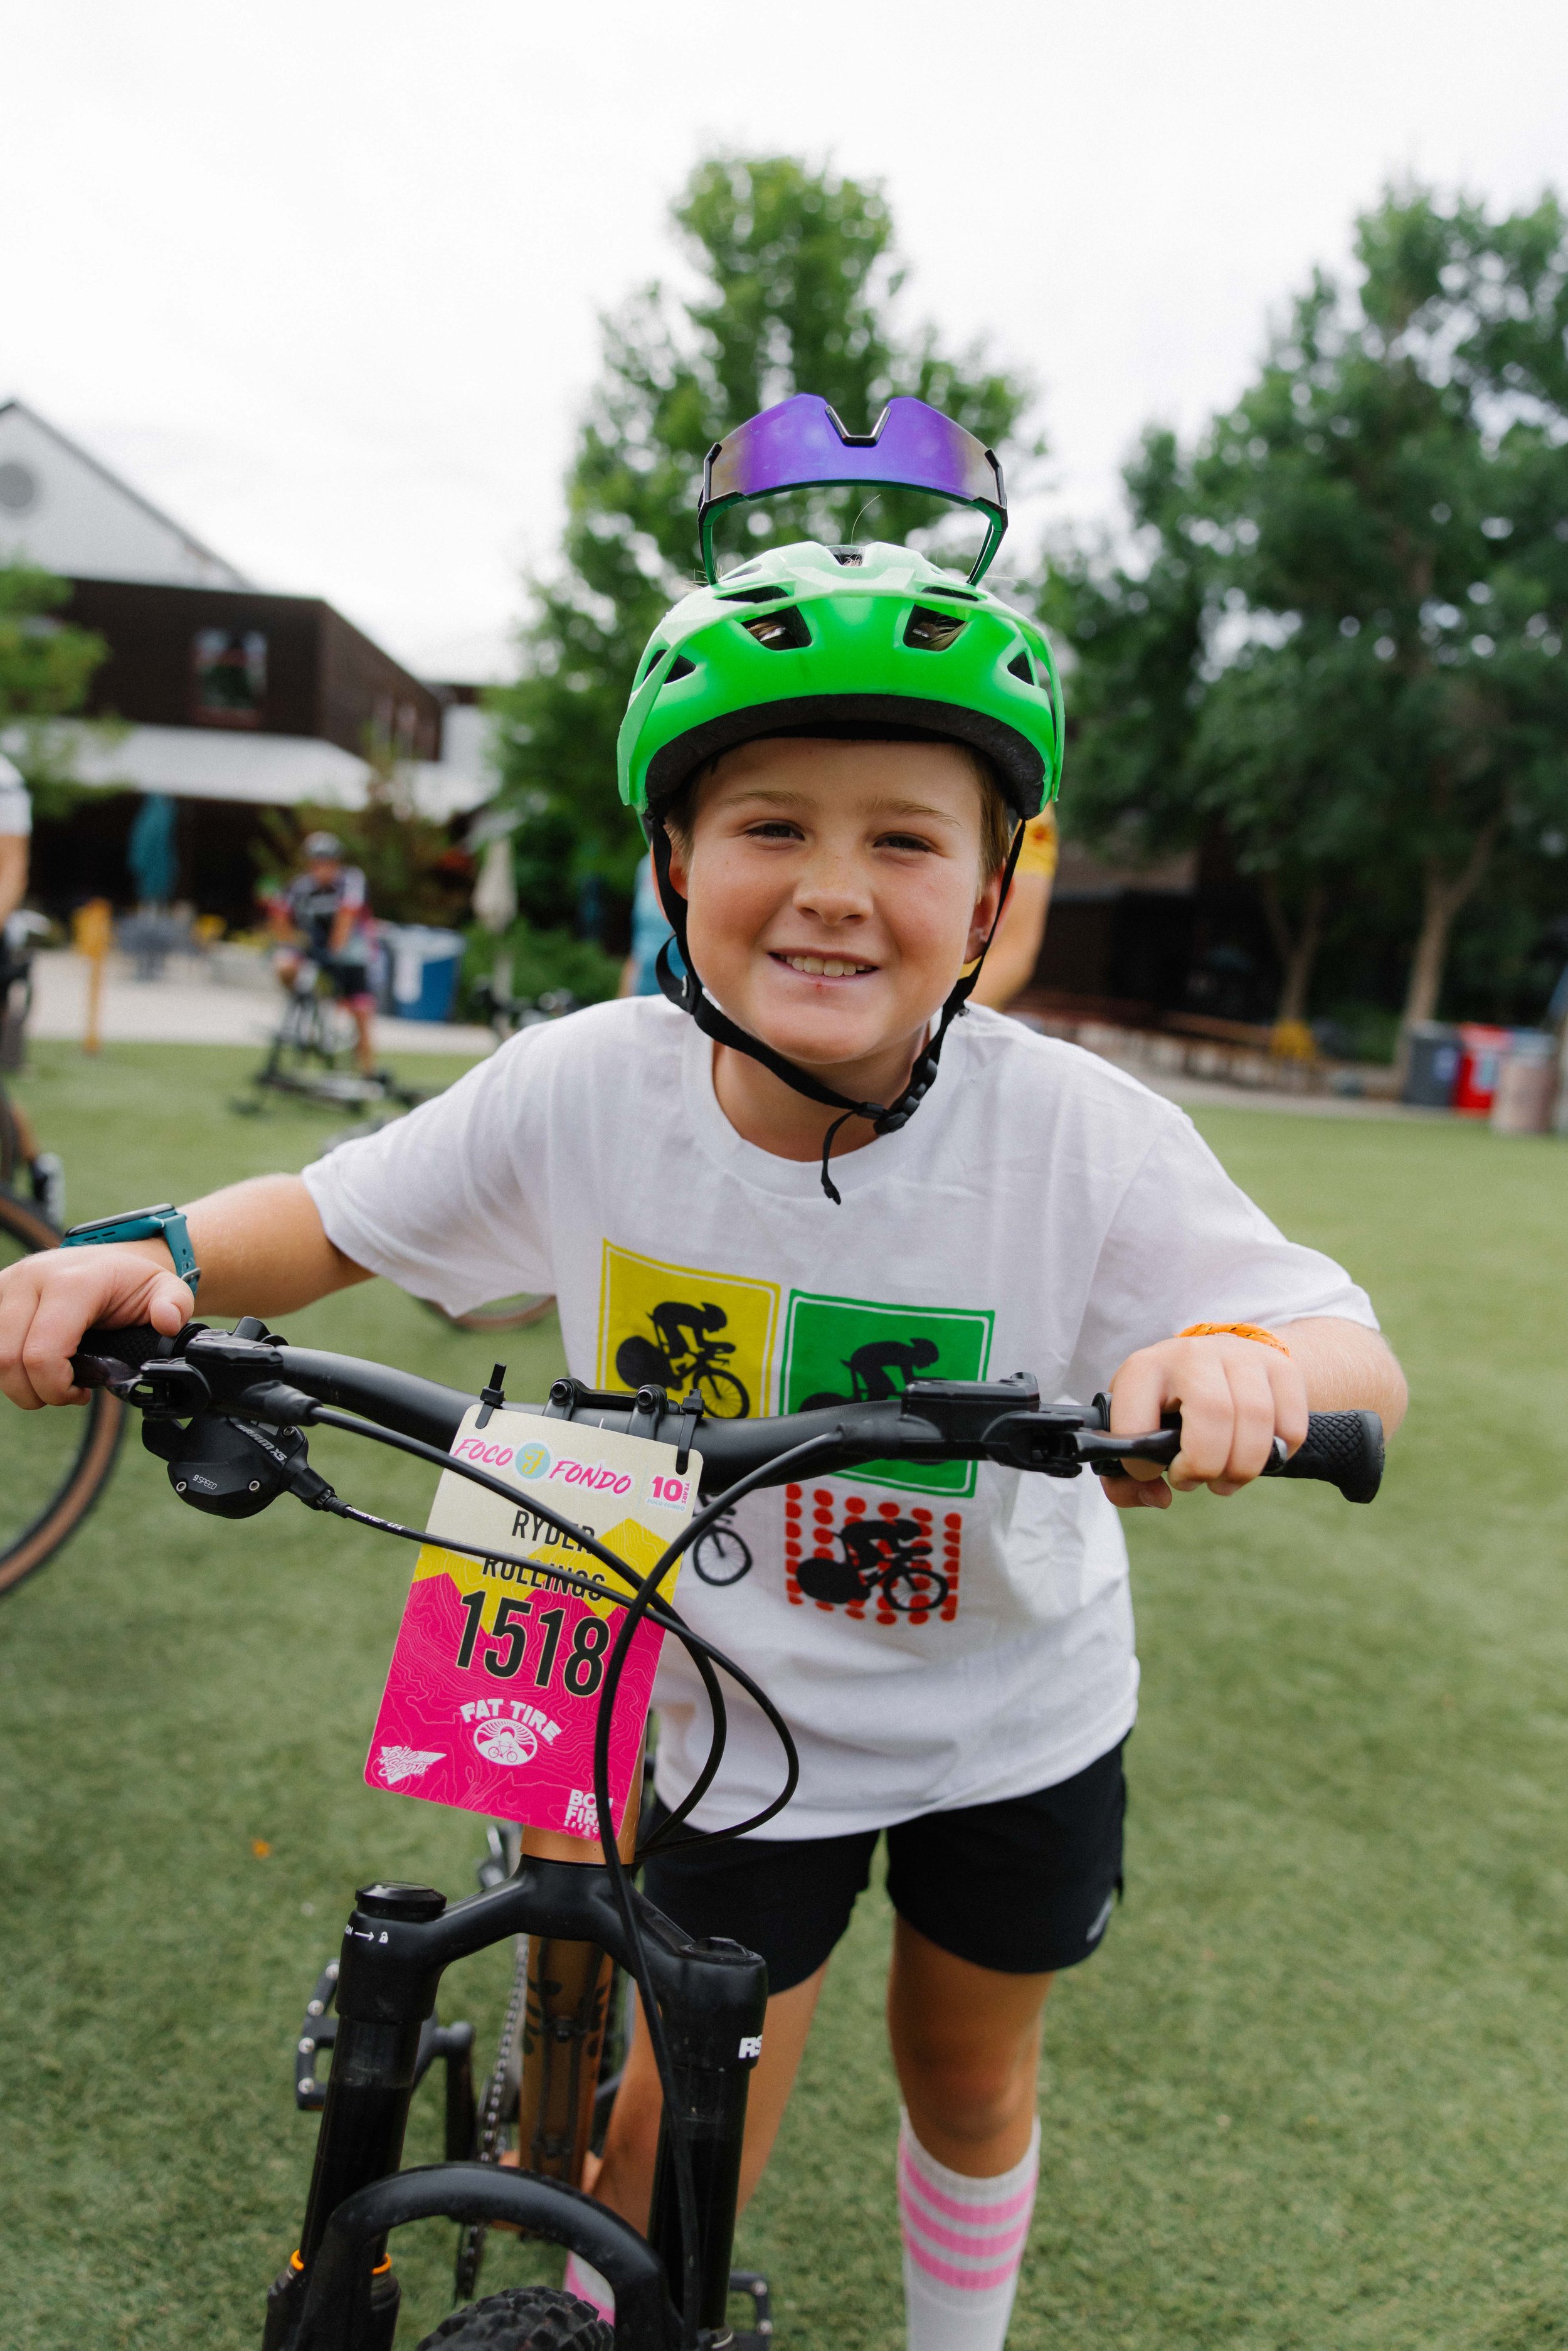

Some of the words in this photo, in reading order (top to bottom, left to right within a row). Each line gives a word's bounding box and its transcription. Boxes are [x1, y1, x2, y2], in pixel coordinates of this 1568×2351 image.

[235, 1424, 275, 1450] SRAM
[453, 1438, 513, 1466] FOCO
[549, 1460, 631, 1494] FONDO
[652, 1476, 683, 1502] 10
[681, 1482, 691, 1504] YEARS
[647, 1498, 663, 1506] FOCO
[664, 1502, 686, 1510] FONDO
[455, 1589, 611, 1697] 1518
[460, 1699, 504, 1723] FAT
[510, 1700, 562, 1743] TIRE
[569, 1788, 613, 1810] BO
[564, 1820, 599, 1834] EFFEC
[565, 1805, 600, 1827] FIR
